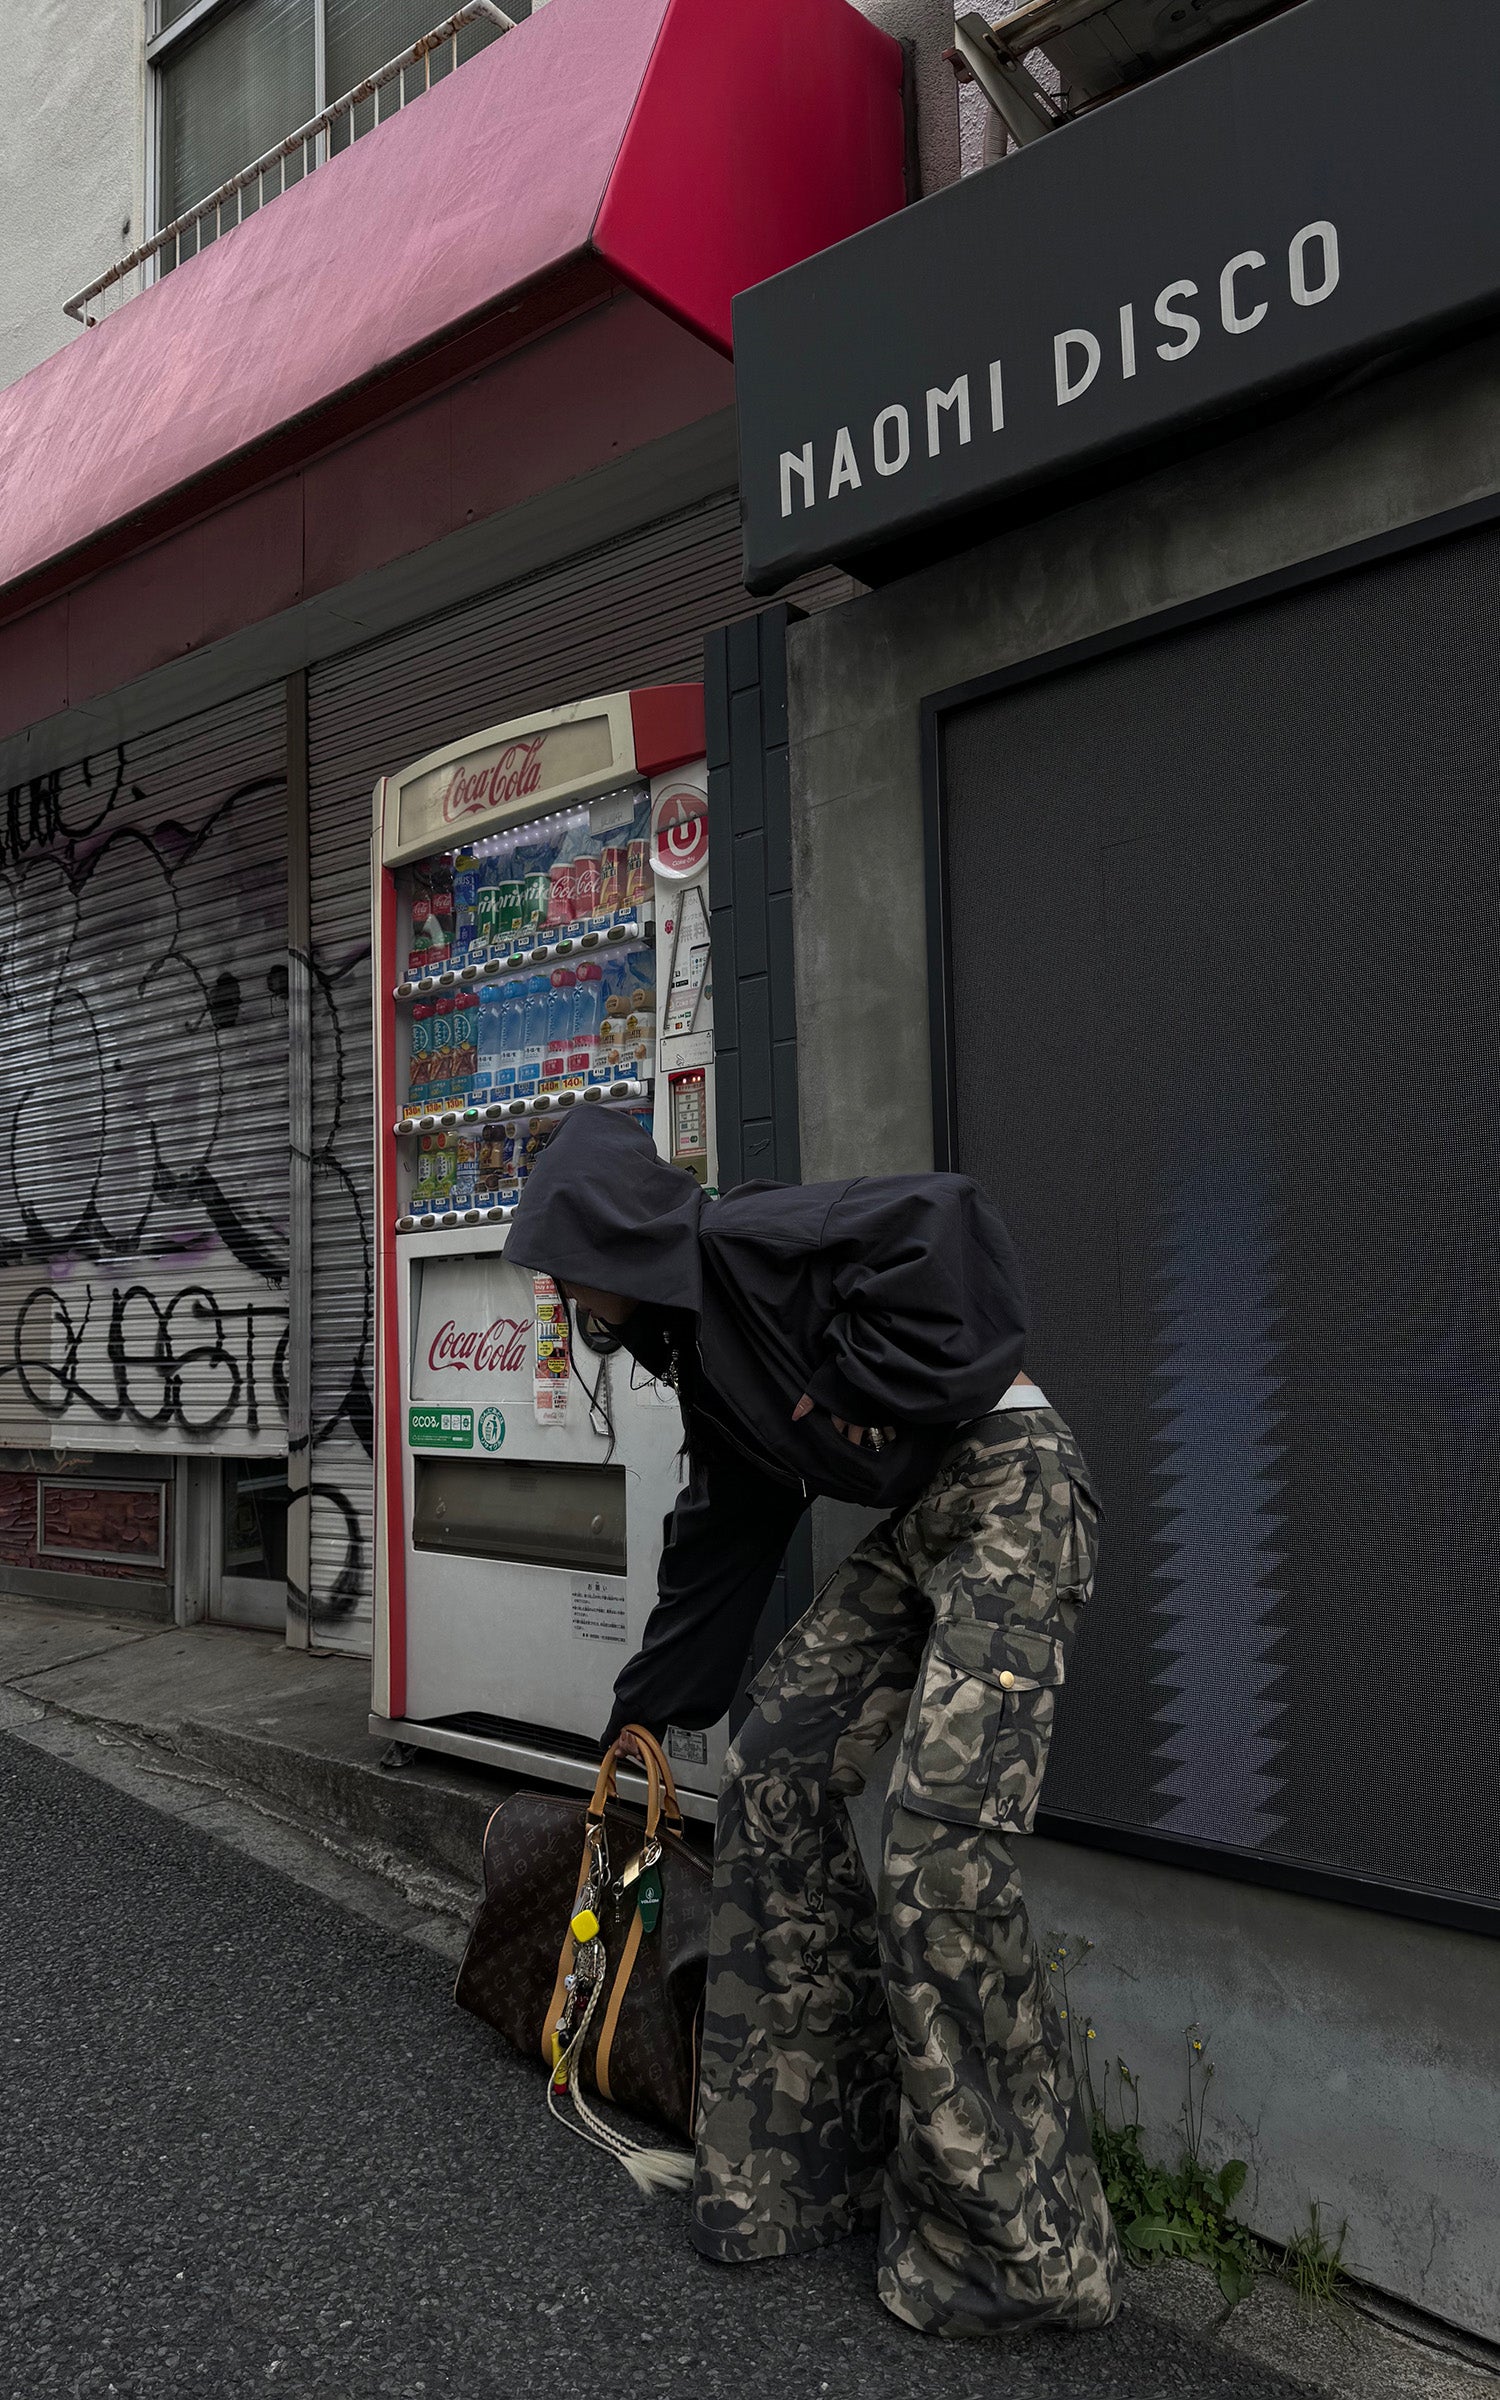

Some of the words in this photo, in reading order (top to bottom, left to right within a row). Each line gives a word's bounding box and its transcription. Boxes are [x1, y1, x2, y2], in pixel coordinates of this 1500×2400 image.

[780, 360, 1004, 519] NAOMI
[1054, 220, 1340, 407] DISCO
[443, 736, 547, 823] Coca-Cola
[428, 1319, 535, 1372] Coca-Cola
